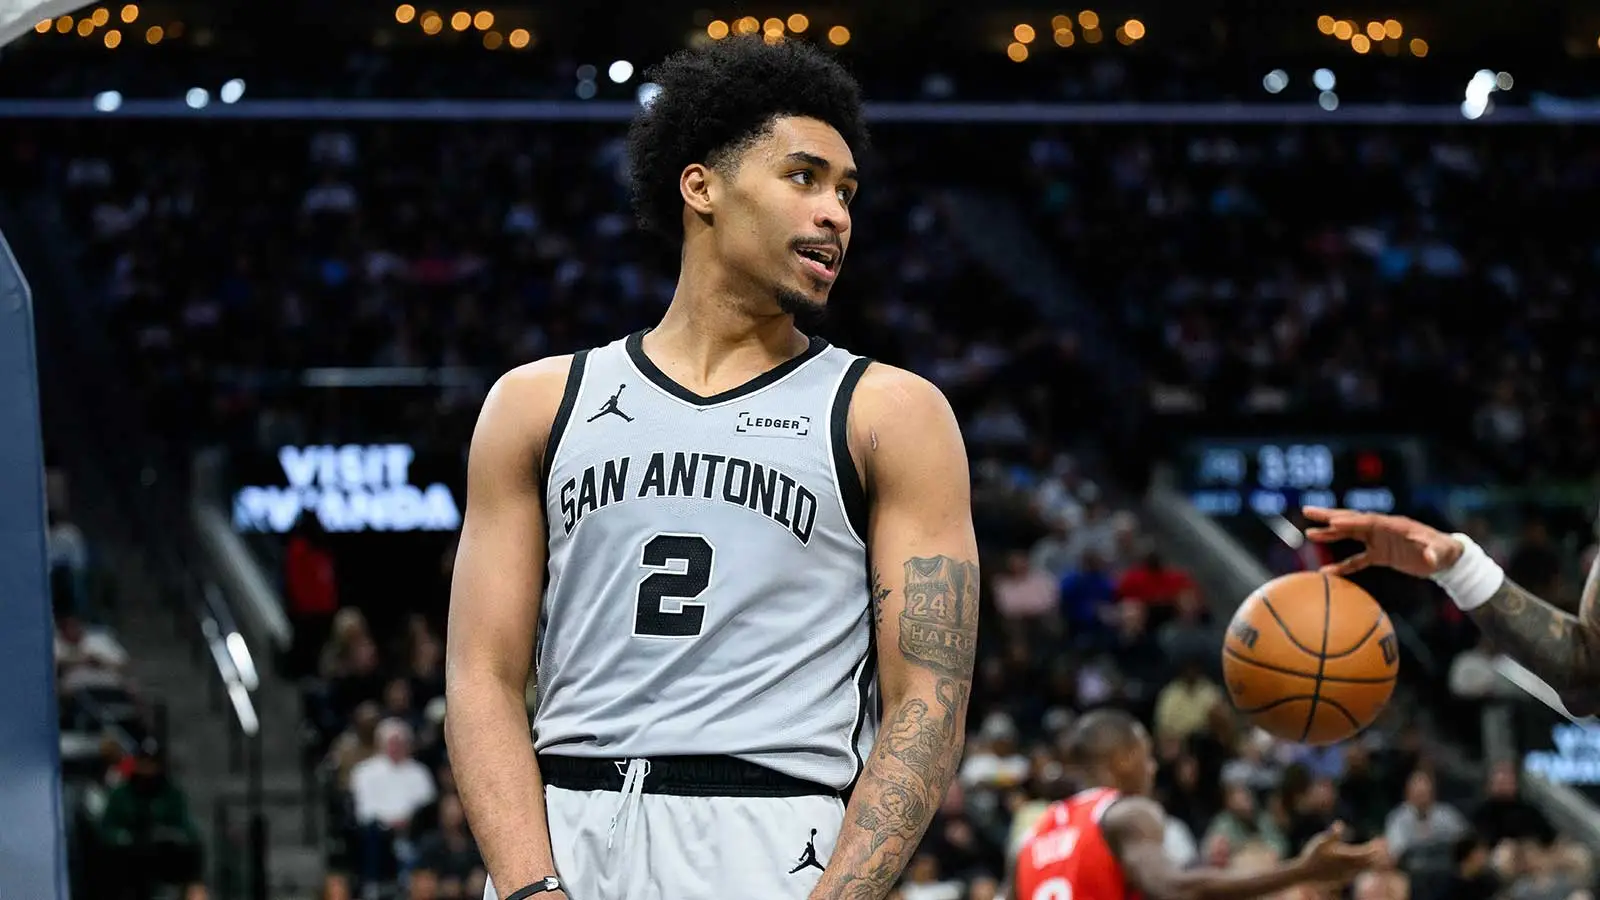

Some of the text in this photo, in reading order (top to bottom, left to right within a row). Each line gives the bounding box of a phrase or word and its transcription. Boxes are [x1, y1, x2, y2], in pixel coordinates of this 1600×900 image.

[746, 417, 800, 429] LEDGER
[560, 451, 818, 547] SAN ANTONIO
[632, 532, 715, 638] 2
[912, 592, 946, 617] 24
